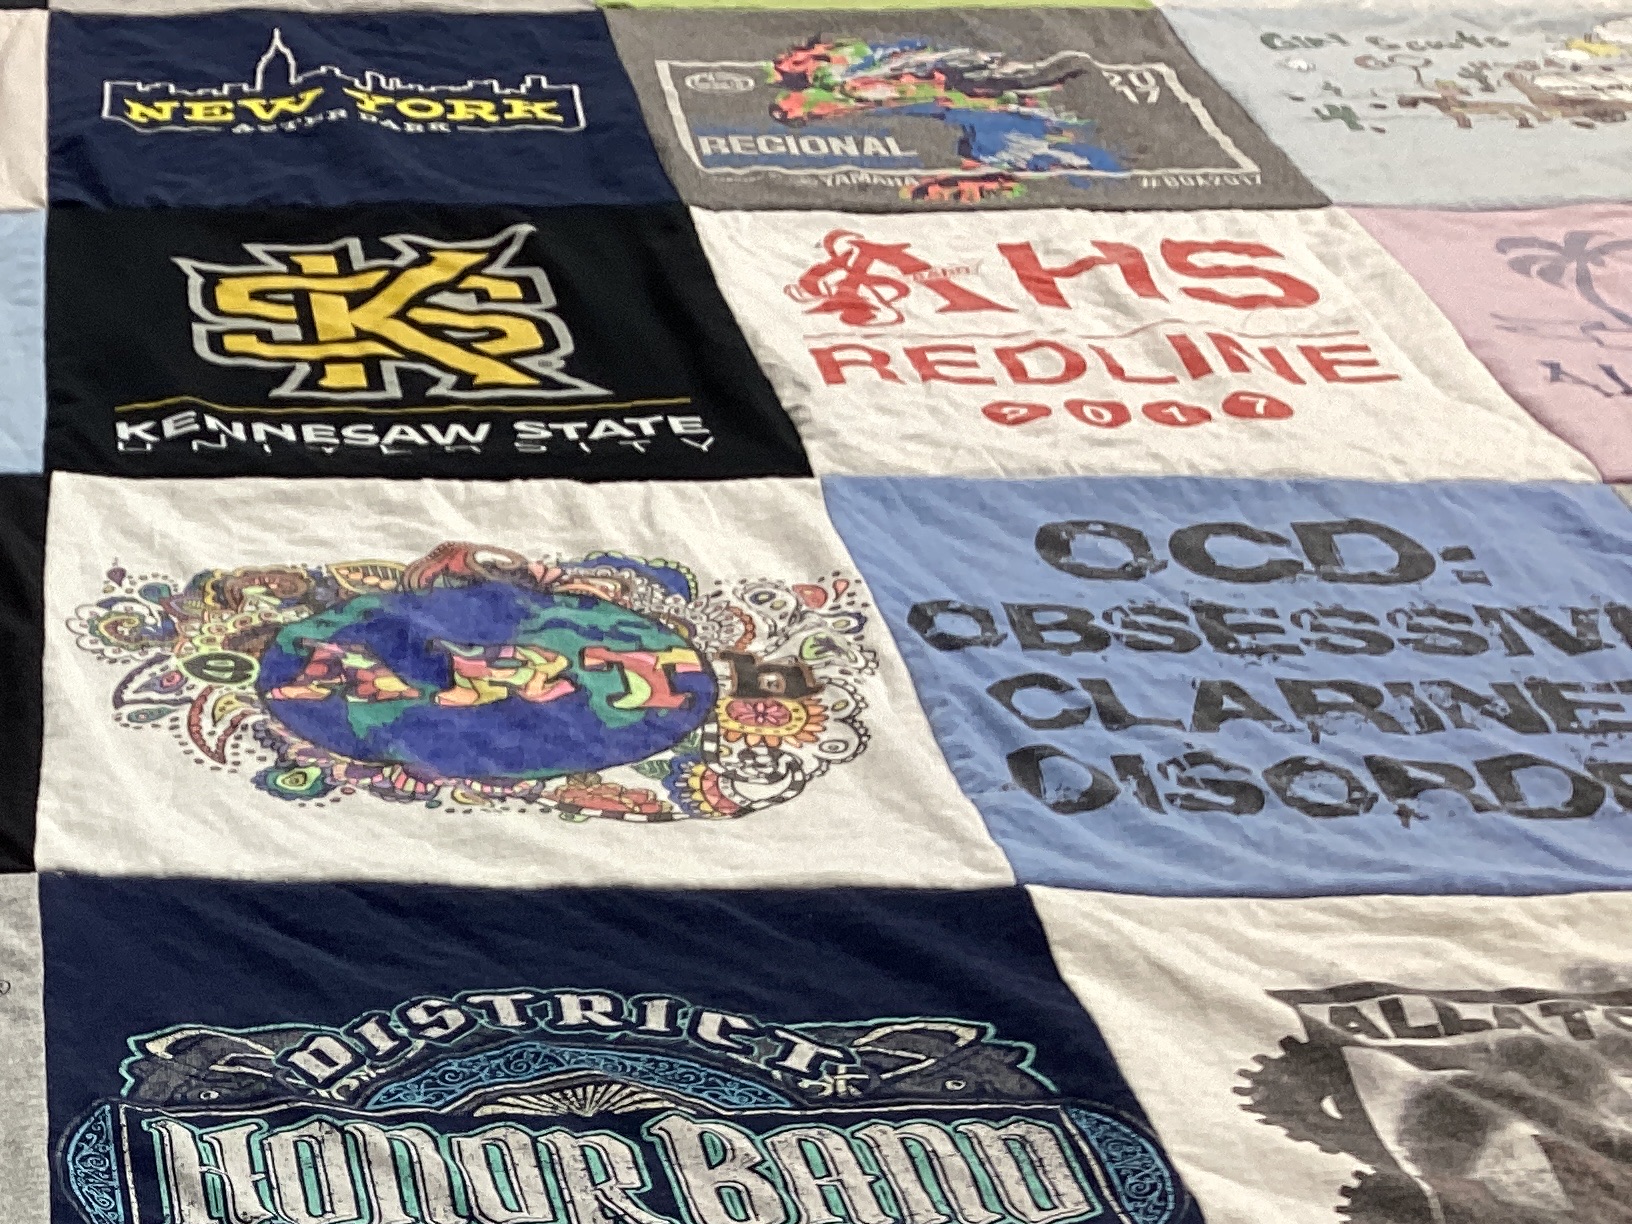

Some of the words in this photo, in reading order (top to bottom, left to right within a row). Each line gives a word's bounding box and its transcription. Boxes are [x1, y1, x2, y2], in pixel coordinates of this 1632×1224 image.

[123, 86, 325, 122] NEW
[342, 86, 565, 122] YORK
[698, 134, 918, 157] REGIONAL
[820, 172, 920, 188] YAMAHA
[808, 333, 1402, 386] REDLINE
[115, 411, 491, 447] KENNESAW
[512, 414, 711, 441] STATE
[1034, 519, 1492, 586] OCD:
[985, 672, 1632, 735] CLARINE
[280, 992, 859, 1083] DISTRICT
